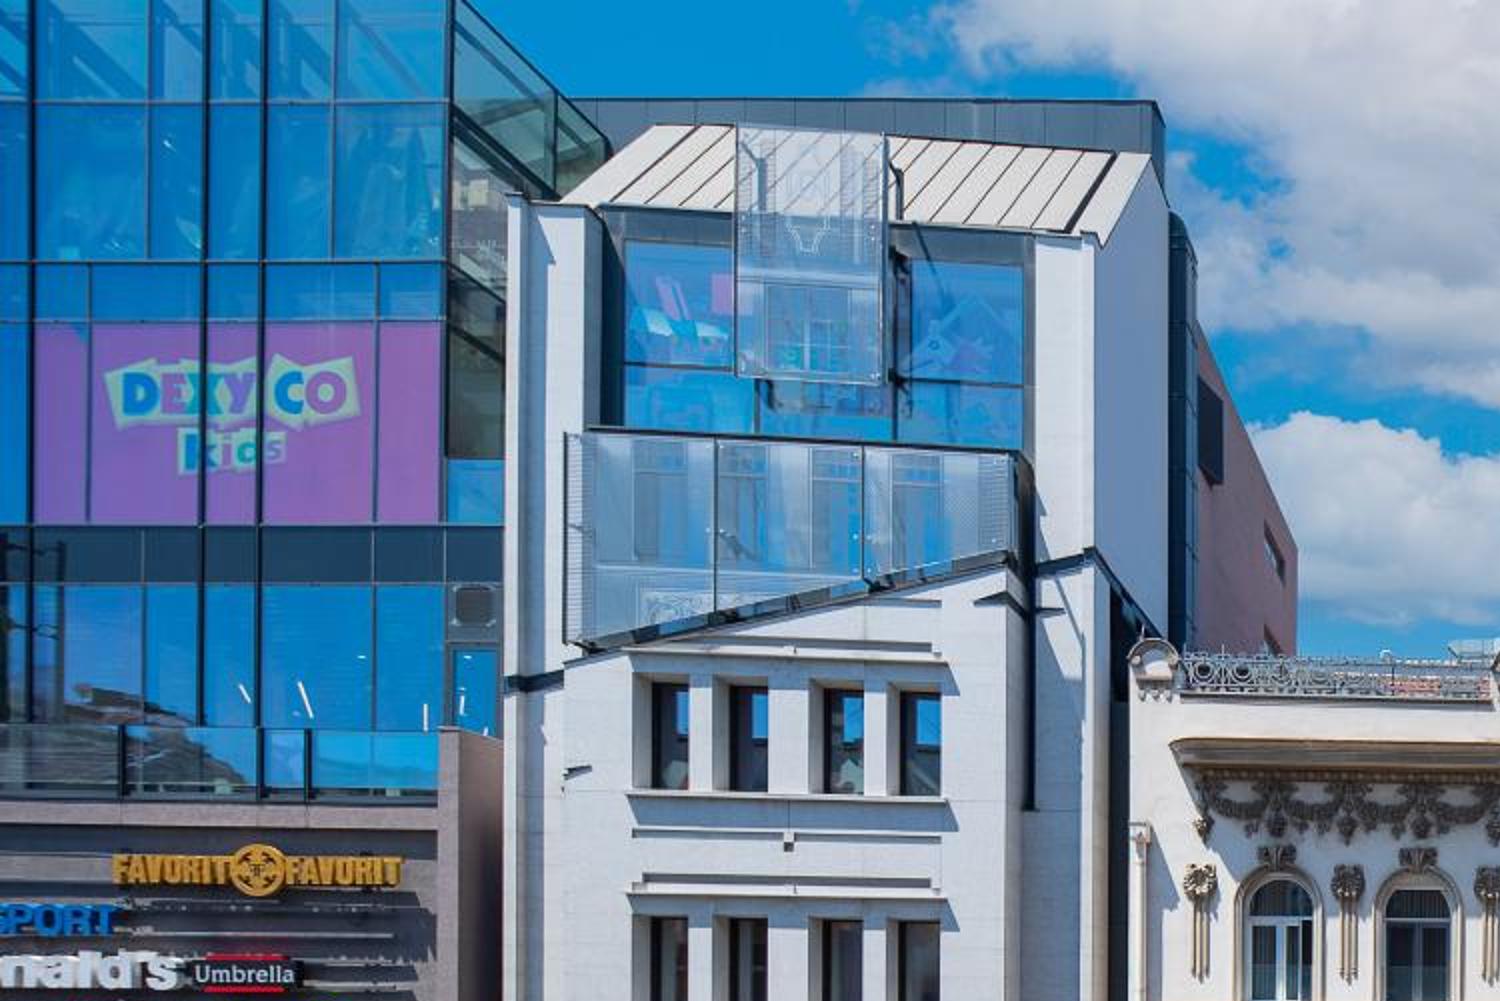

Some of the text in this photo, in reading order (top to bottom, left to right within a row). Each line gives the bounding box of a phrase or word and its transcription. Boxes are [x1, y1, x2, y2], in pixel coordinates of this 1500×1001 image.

[122, 370, 348, 416] DEXY CO
[112, 854, 402, 886] FAVORIT FAVORIT
[195, 964, 295, 983] Umbrella
